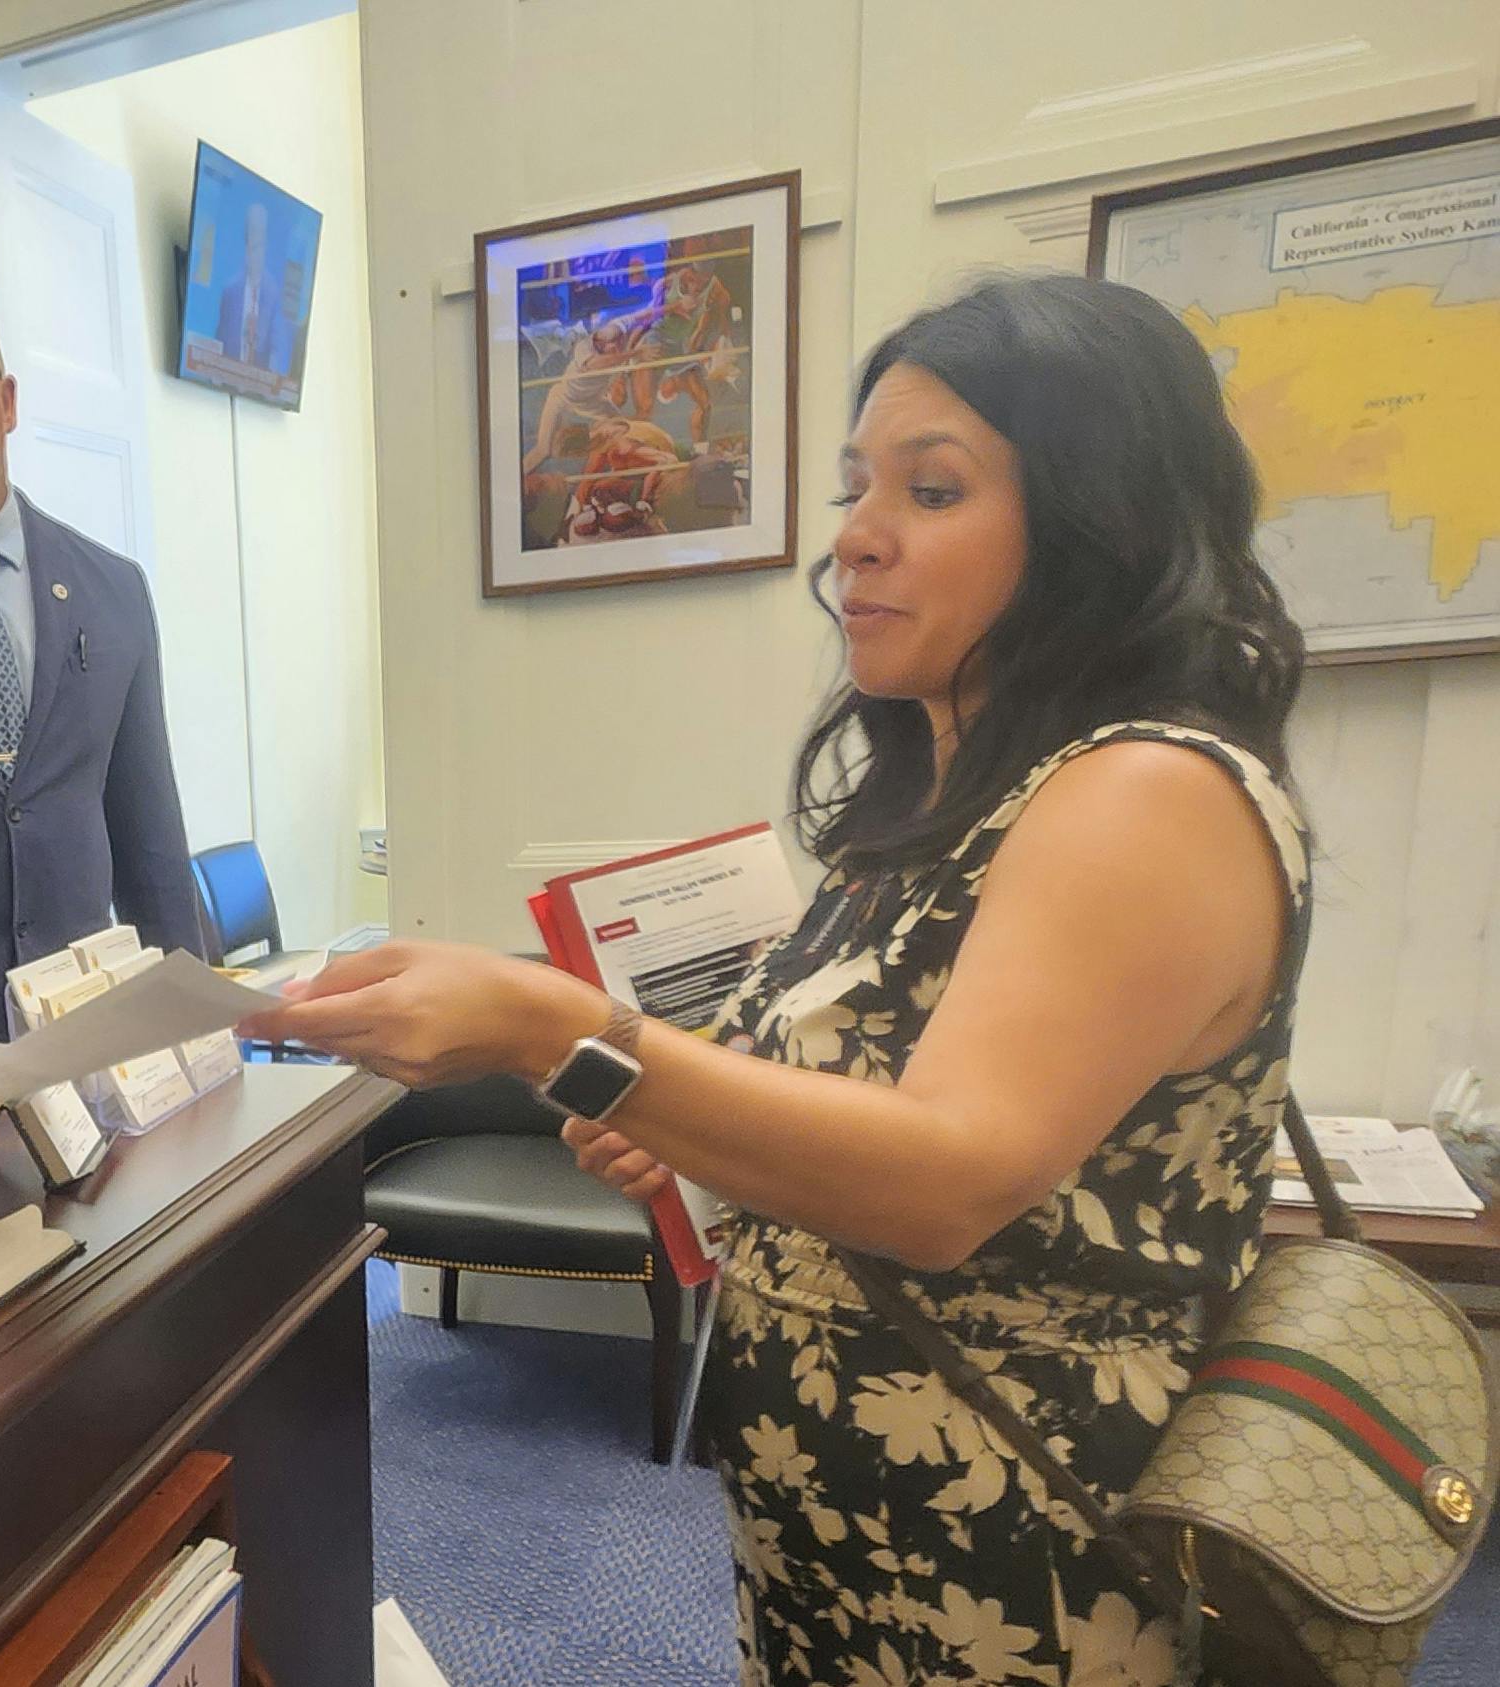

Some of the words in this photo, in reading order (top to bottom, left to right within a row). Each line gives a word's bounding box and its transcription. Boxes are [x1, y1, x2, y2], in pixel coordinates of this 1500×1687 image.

[1290, 215, 1370, 240] California
[1384, 193, 1497, 224] Congressional
[1284, 233, 1397, 263] Representative
[1401, 225, 1454, 244] Sydney
